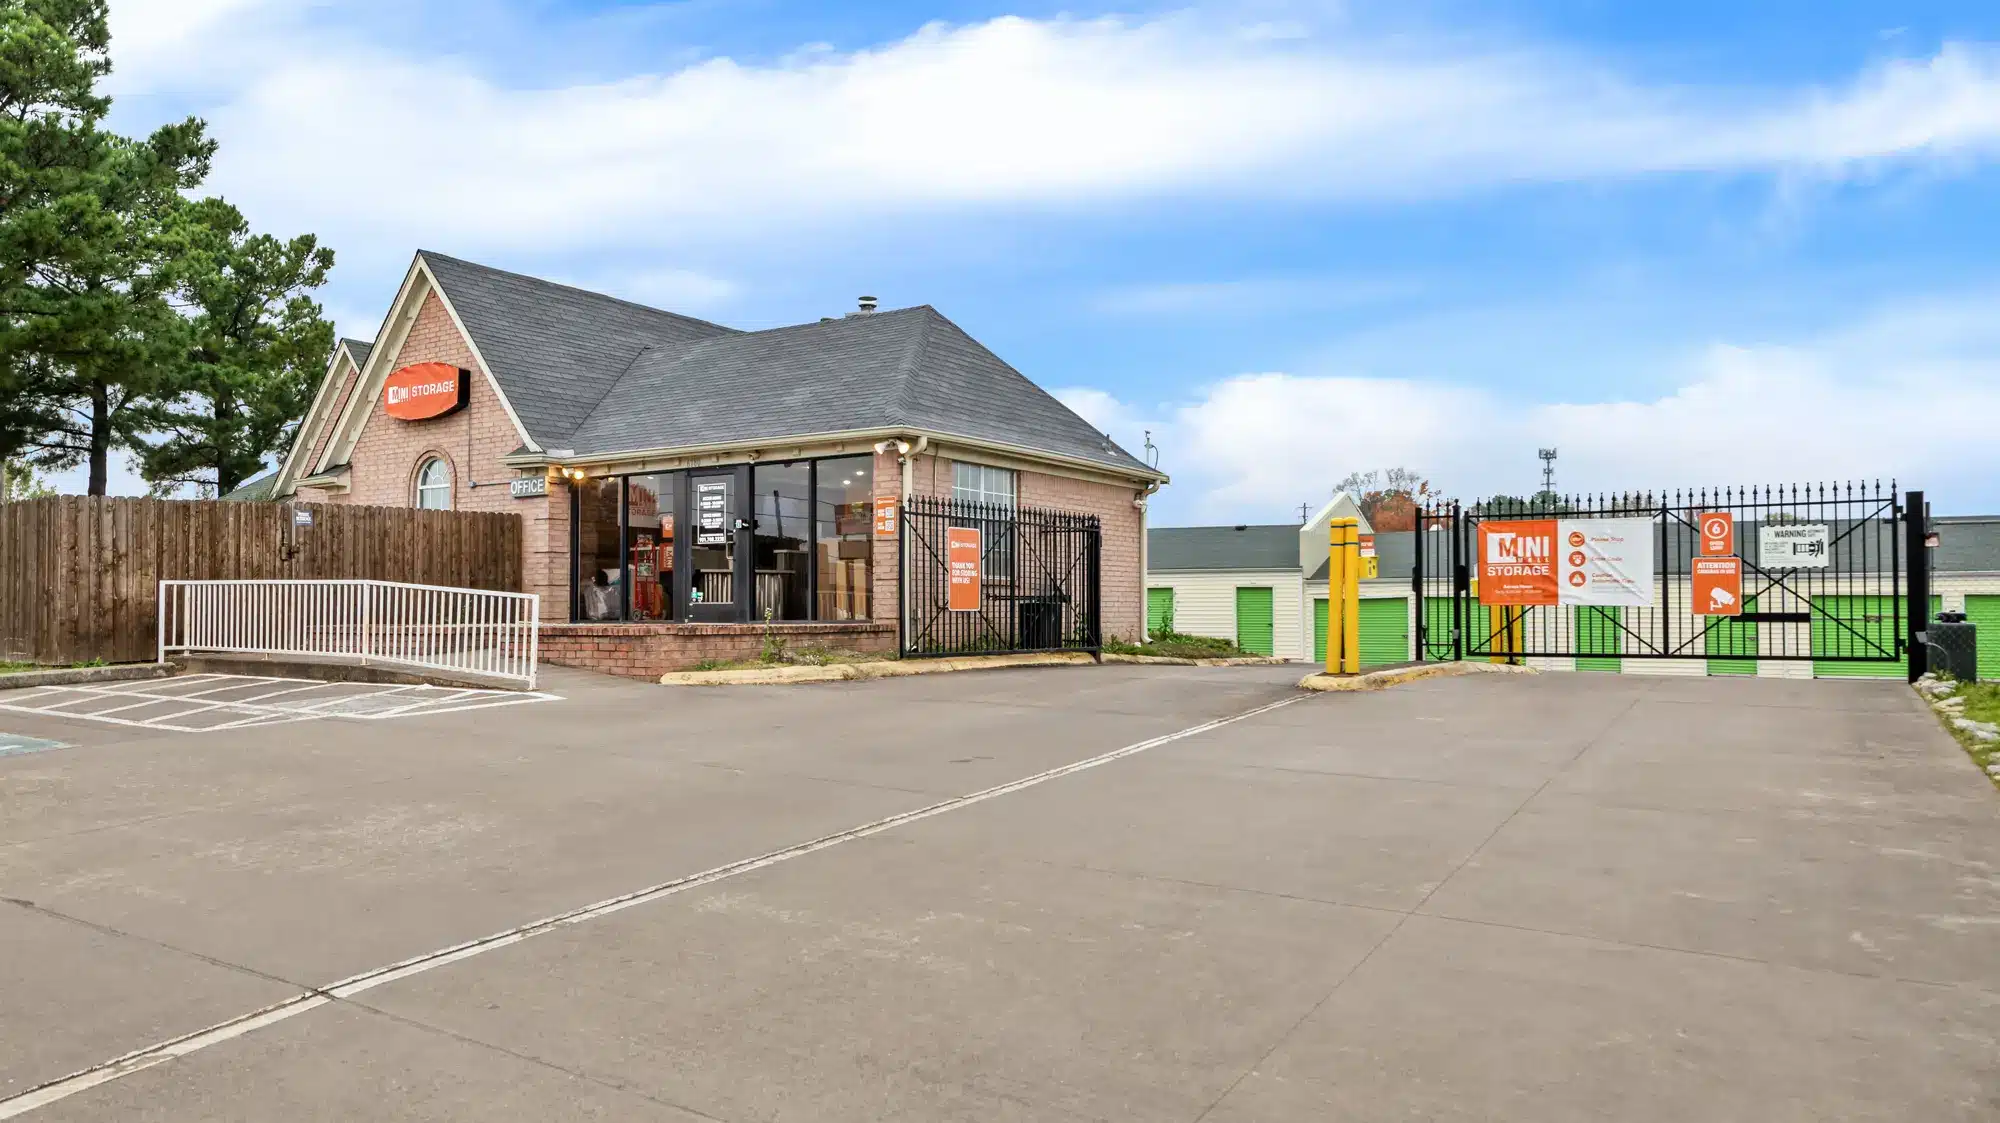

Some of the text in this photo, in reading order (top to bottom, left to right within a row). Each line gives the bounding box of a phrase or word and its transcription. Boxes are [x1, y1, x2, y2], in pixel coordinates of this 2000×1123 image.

[388, 380, 455, 404] MINI STORAGE
[510, 478, 544, 494] OFFICE
[1711, 523, 1721, 534] 6
[1774, 530, 1806, 538] WARNING
[1487, 533, 1549, 560] MINI
[952, 569, 960, 577] FOR
[1487, 566, 1549, 577] STORAGE
